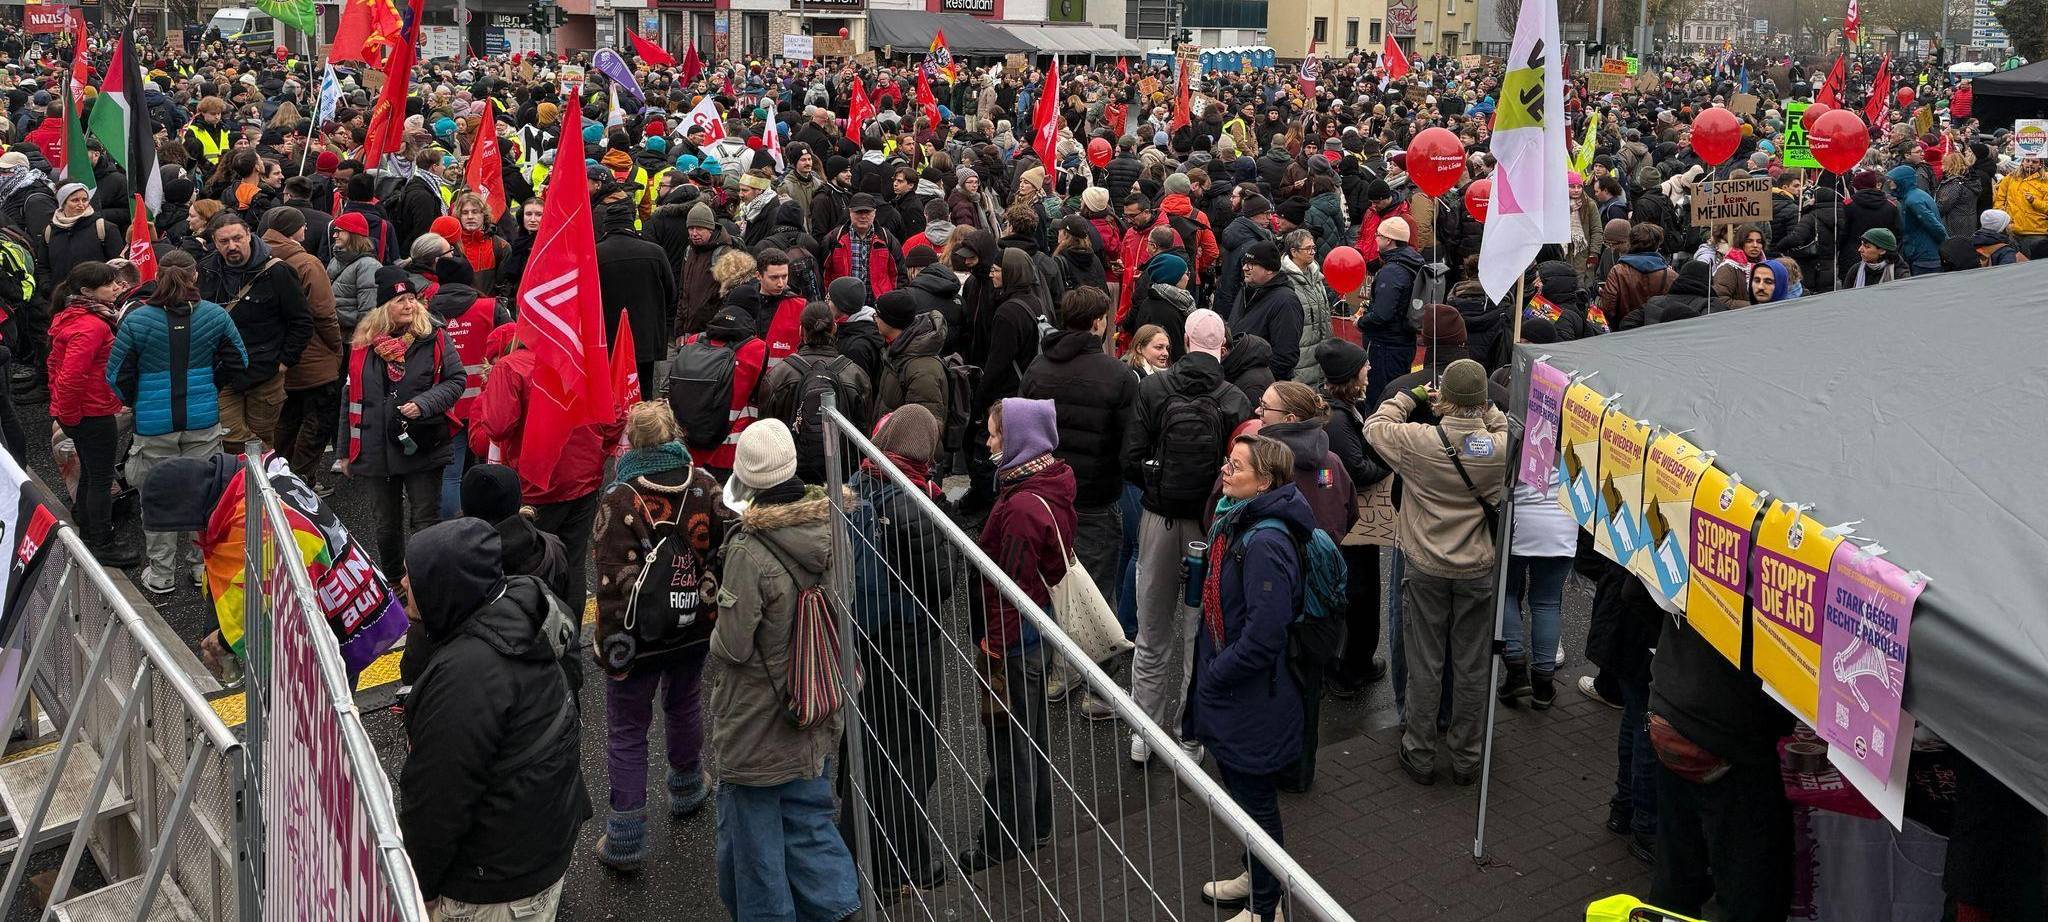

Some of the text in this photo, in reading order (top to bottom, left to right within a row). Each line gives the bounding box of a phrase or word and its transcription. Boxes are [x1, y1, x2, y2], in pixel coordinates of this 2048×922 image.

[945, 0, 993, 10] Restaurant
[1697, 201, 1760, 220] MEINUNG
[1565, 397, 1574, 411] NIE
[1573, 402, 1591, 424] WIEDER
[1603, 427, 1613, 443] NIE
[1612, 432, 1633, 454] WIEDER
[1650, 447, 1663, 464] NIE
[1661, 454, 1686, 480] WIEDER
[1697, 516, 1741, 556] STOPPT
[1697, 544, 1740, 586] DIE AFD
[1761, 555, 1816, 602] STOPPT
[343, 577, 383, 628] auf
[1761, 583, 1783, 619] DIE
[1785, 595, 1815, 634] AFD
[1836, 587, 1898, 635] STARK GEGEN
[1826, 604, 1905, 664] RECHTE PAROLEN
